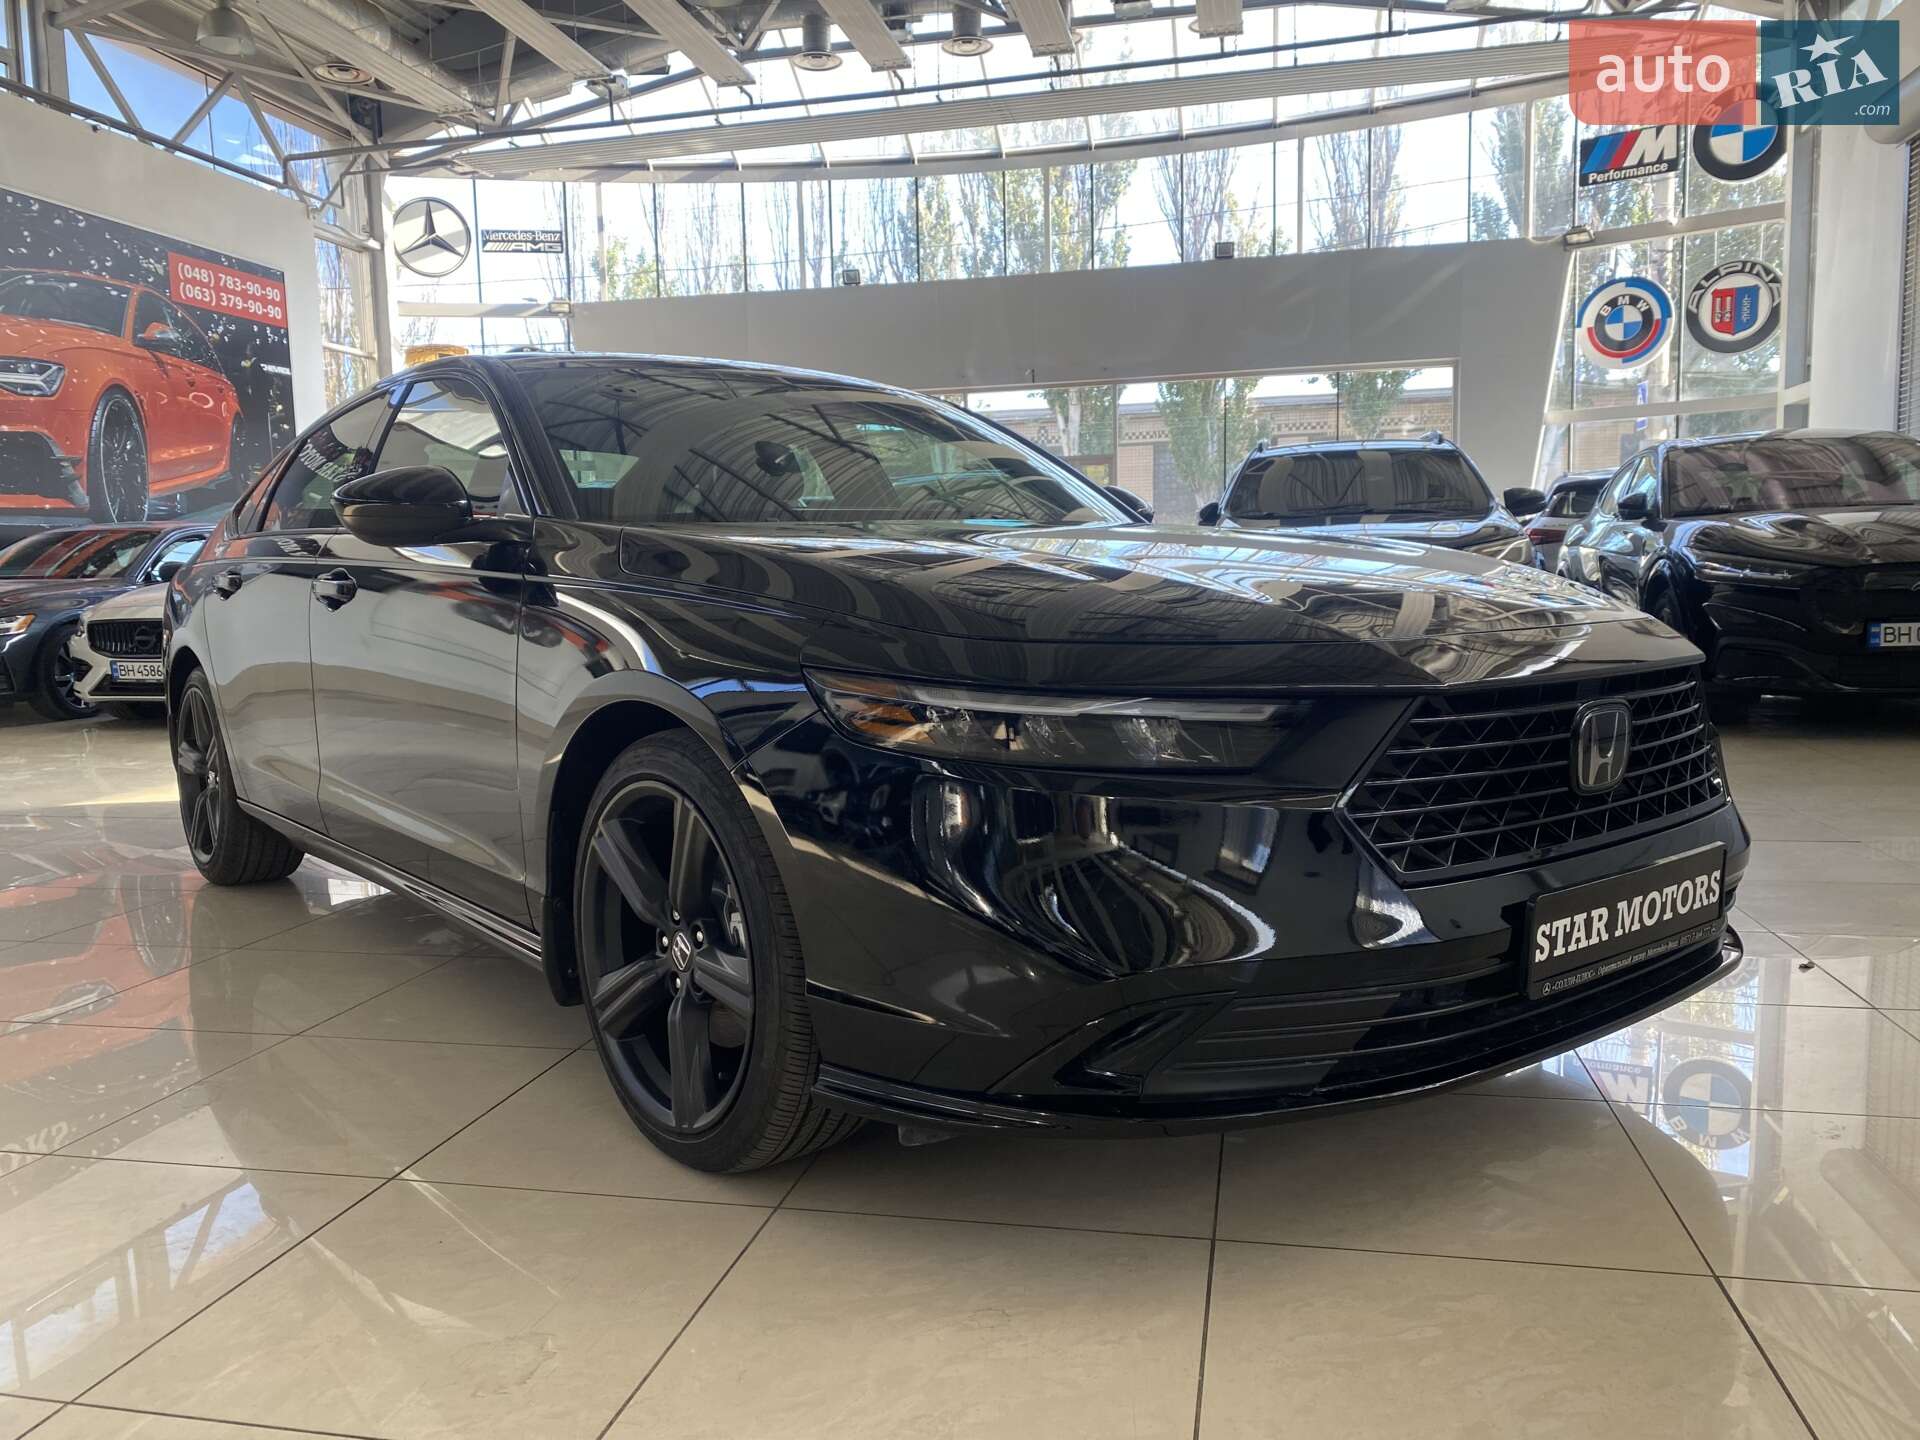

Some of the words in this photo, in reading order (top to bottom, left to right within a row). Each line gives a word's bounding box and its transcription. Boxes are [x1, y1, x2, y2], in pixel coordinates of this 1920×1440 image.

[1588, 161, 1669, 184] Performance
[482, 230, 561, 241] Mercedes-Benz
[508, 241, 562, 252] AMG
[178, 262, 215, 288] (048)
[219, 273, 281, 302] 783-90-90
[1688, 261, 1782, 314] ALPINA
[179, 282, 216, 307] (063)
[220, 292, 282, 320] 379-90-90
[1600, 295, 1651, 317] BMW
[1883, 626, 1913, 644] BH
[118, 664, 136, 677] BH
[137, 664, 163, 677] 4586
[1534, 906, 1610, 963] STAR
[1614, 869, 1721, 937] MOTORS
